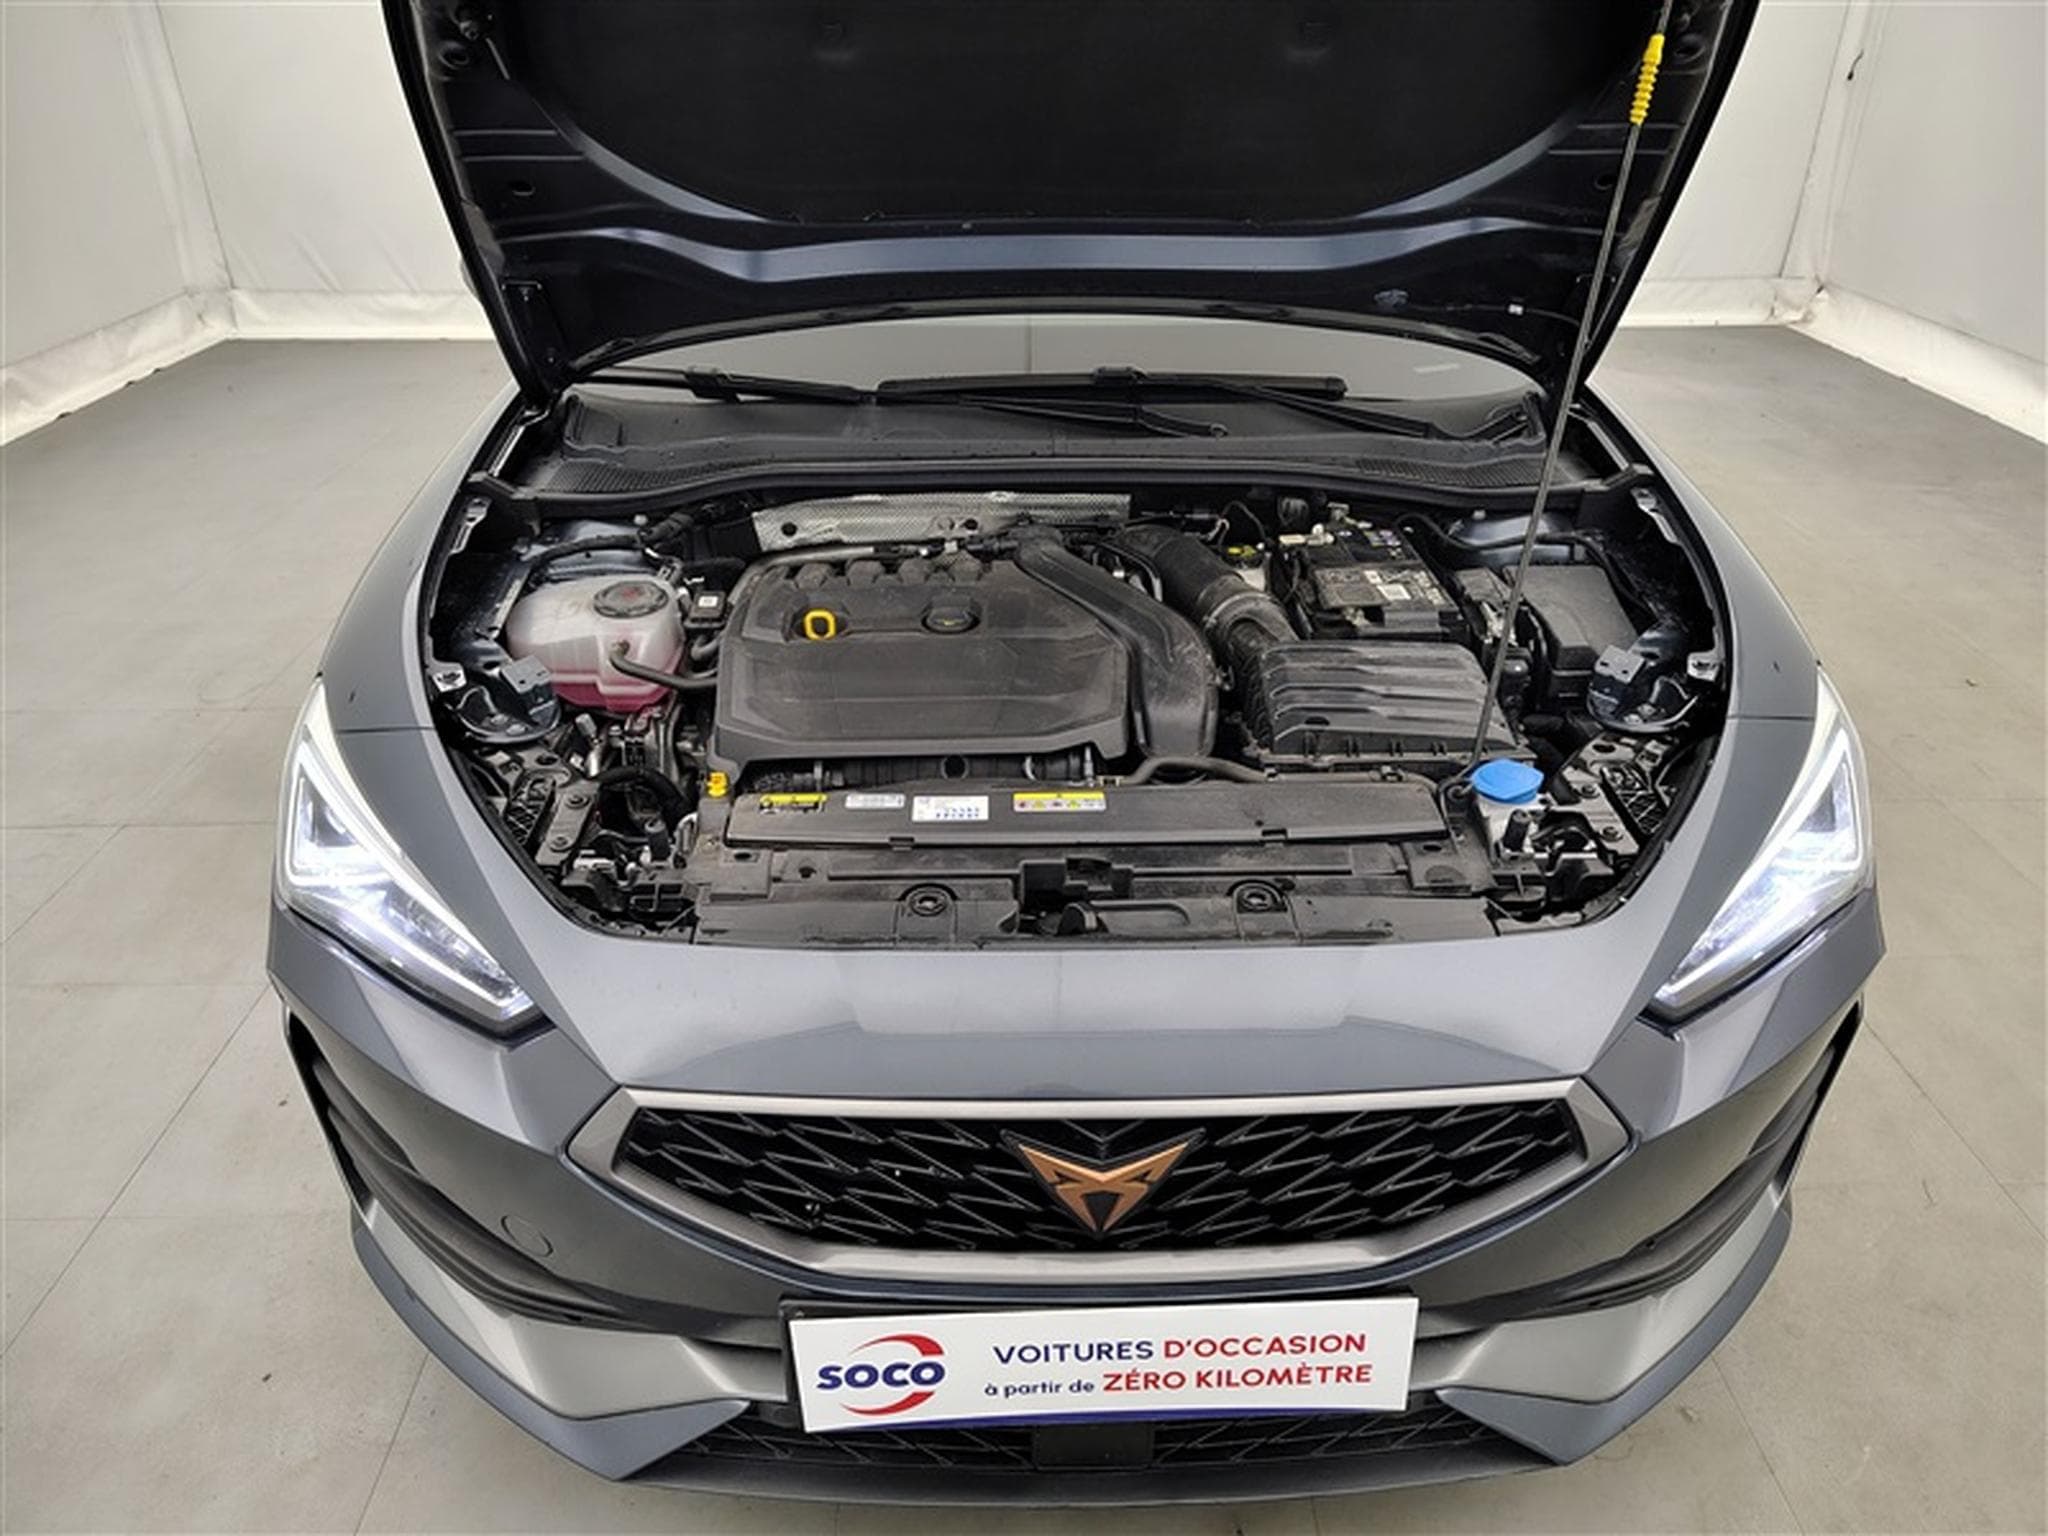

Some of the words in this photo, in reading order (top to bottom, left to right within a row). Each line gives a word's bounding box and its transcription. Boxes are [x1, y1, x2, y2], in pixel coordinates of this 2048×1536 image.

[993, 1340, 1154, 1365] VOITURES
[1163, 1333, 1367, 1359] D'OCCASION
[816, 1361, 946, 1390] SOCO
[984, 1382, 998, 1396] à
[1003, 1381, 1062, 1399] partir
[1068, 1378, 1095, 1393] de
[1103, 1368, 1187, 1392] ZÉRO
[1195, 1361, 1373, 1389] KILOMÈTRE
